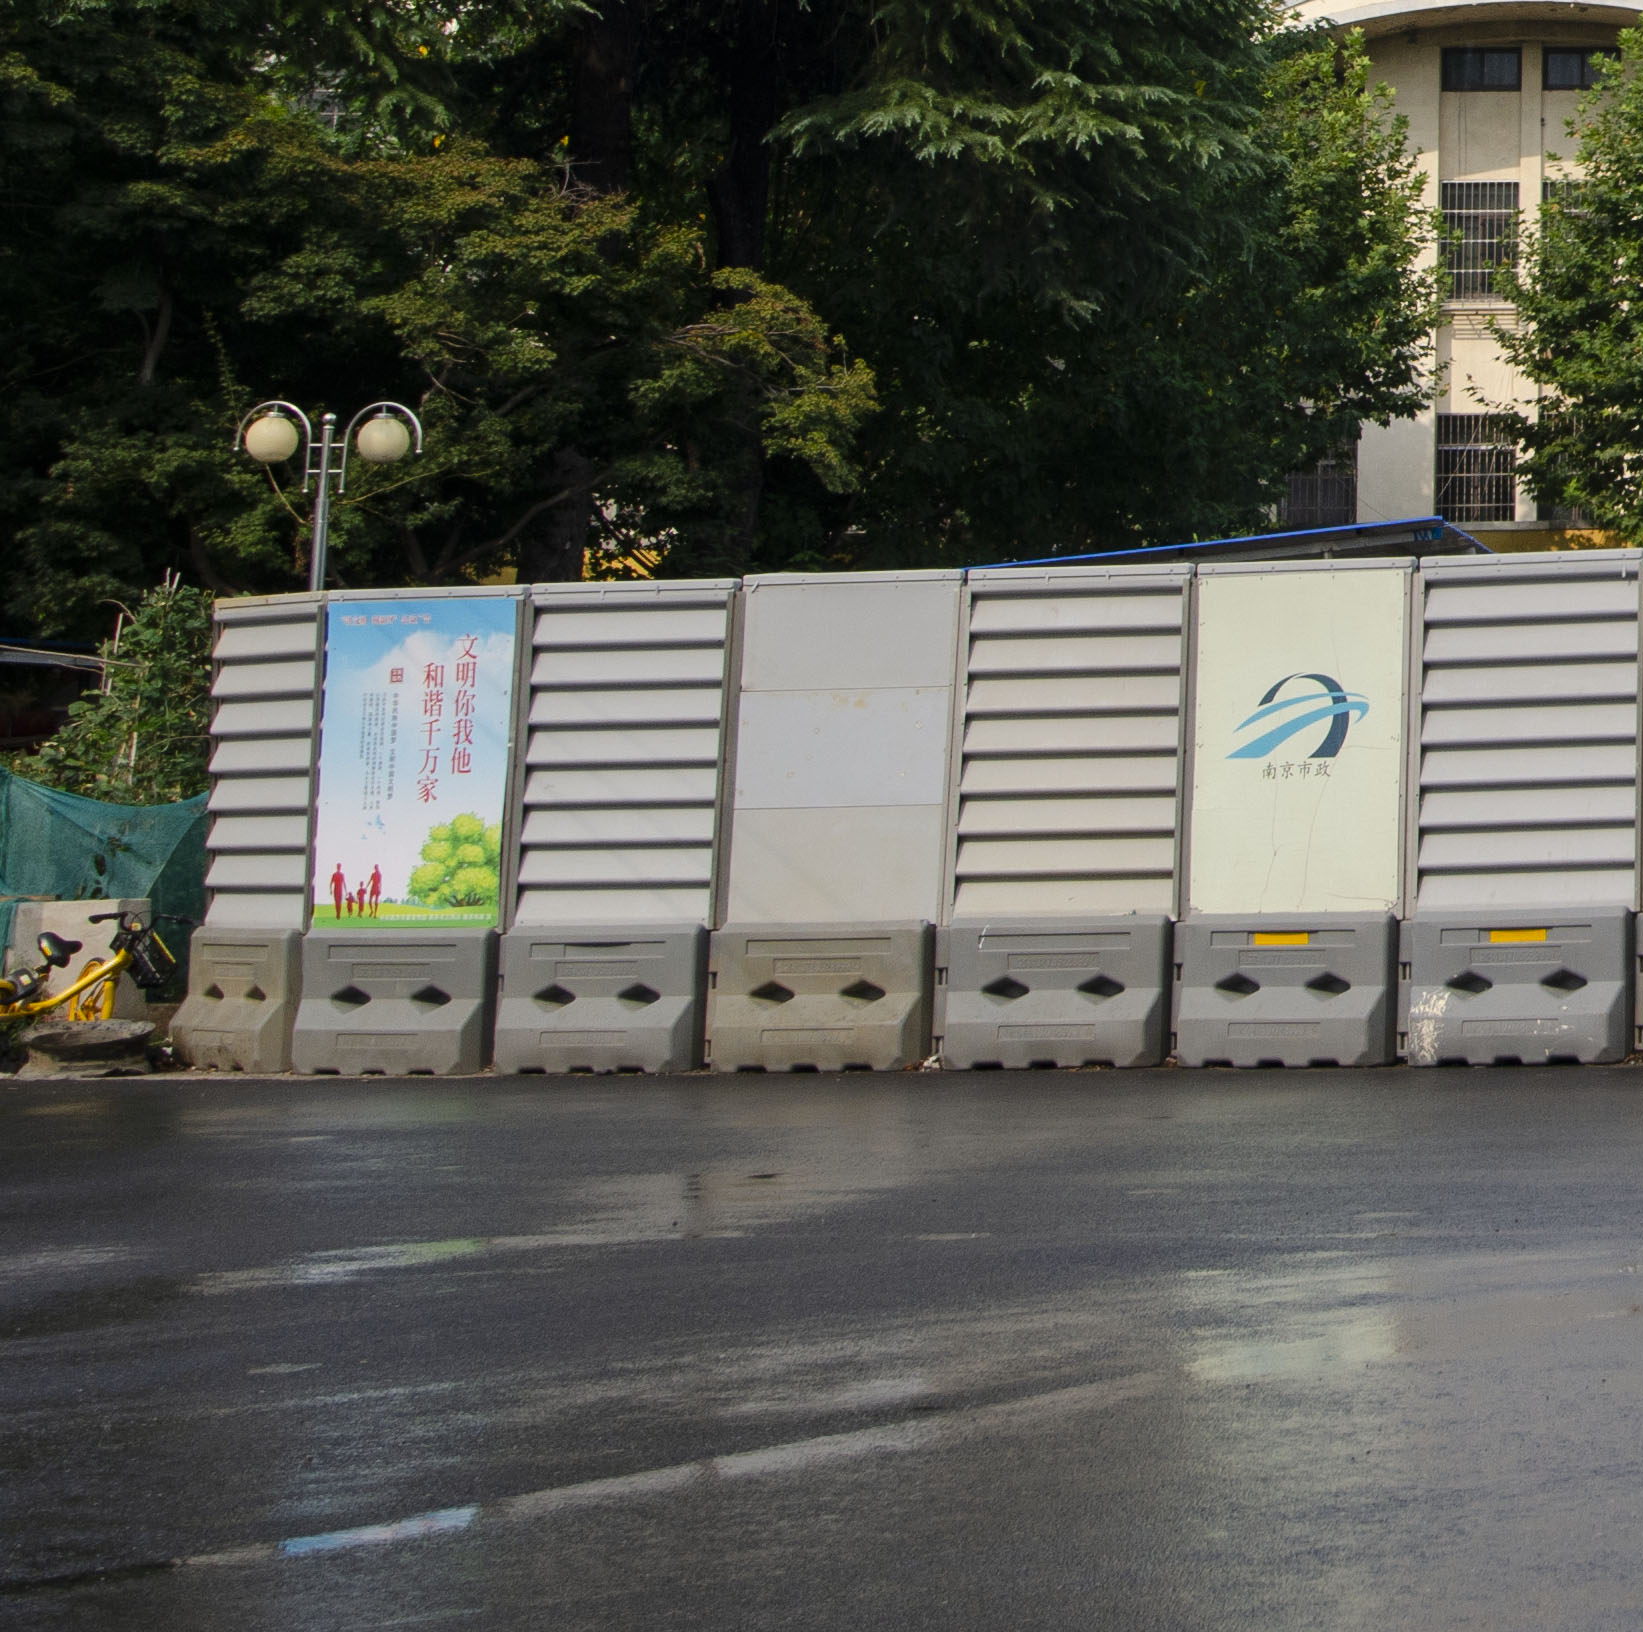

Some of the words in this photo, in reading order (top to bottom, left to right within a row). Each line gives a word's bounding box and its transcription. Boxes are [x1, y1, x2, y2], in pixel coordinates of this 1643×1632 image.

[416, 662, 445, 803] 和谐千万家
[450, 633, 479, 775] 文明你我他
[1262, 760, 1331, 780] 南京市政
